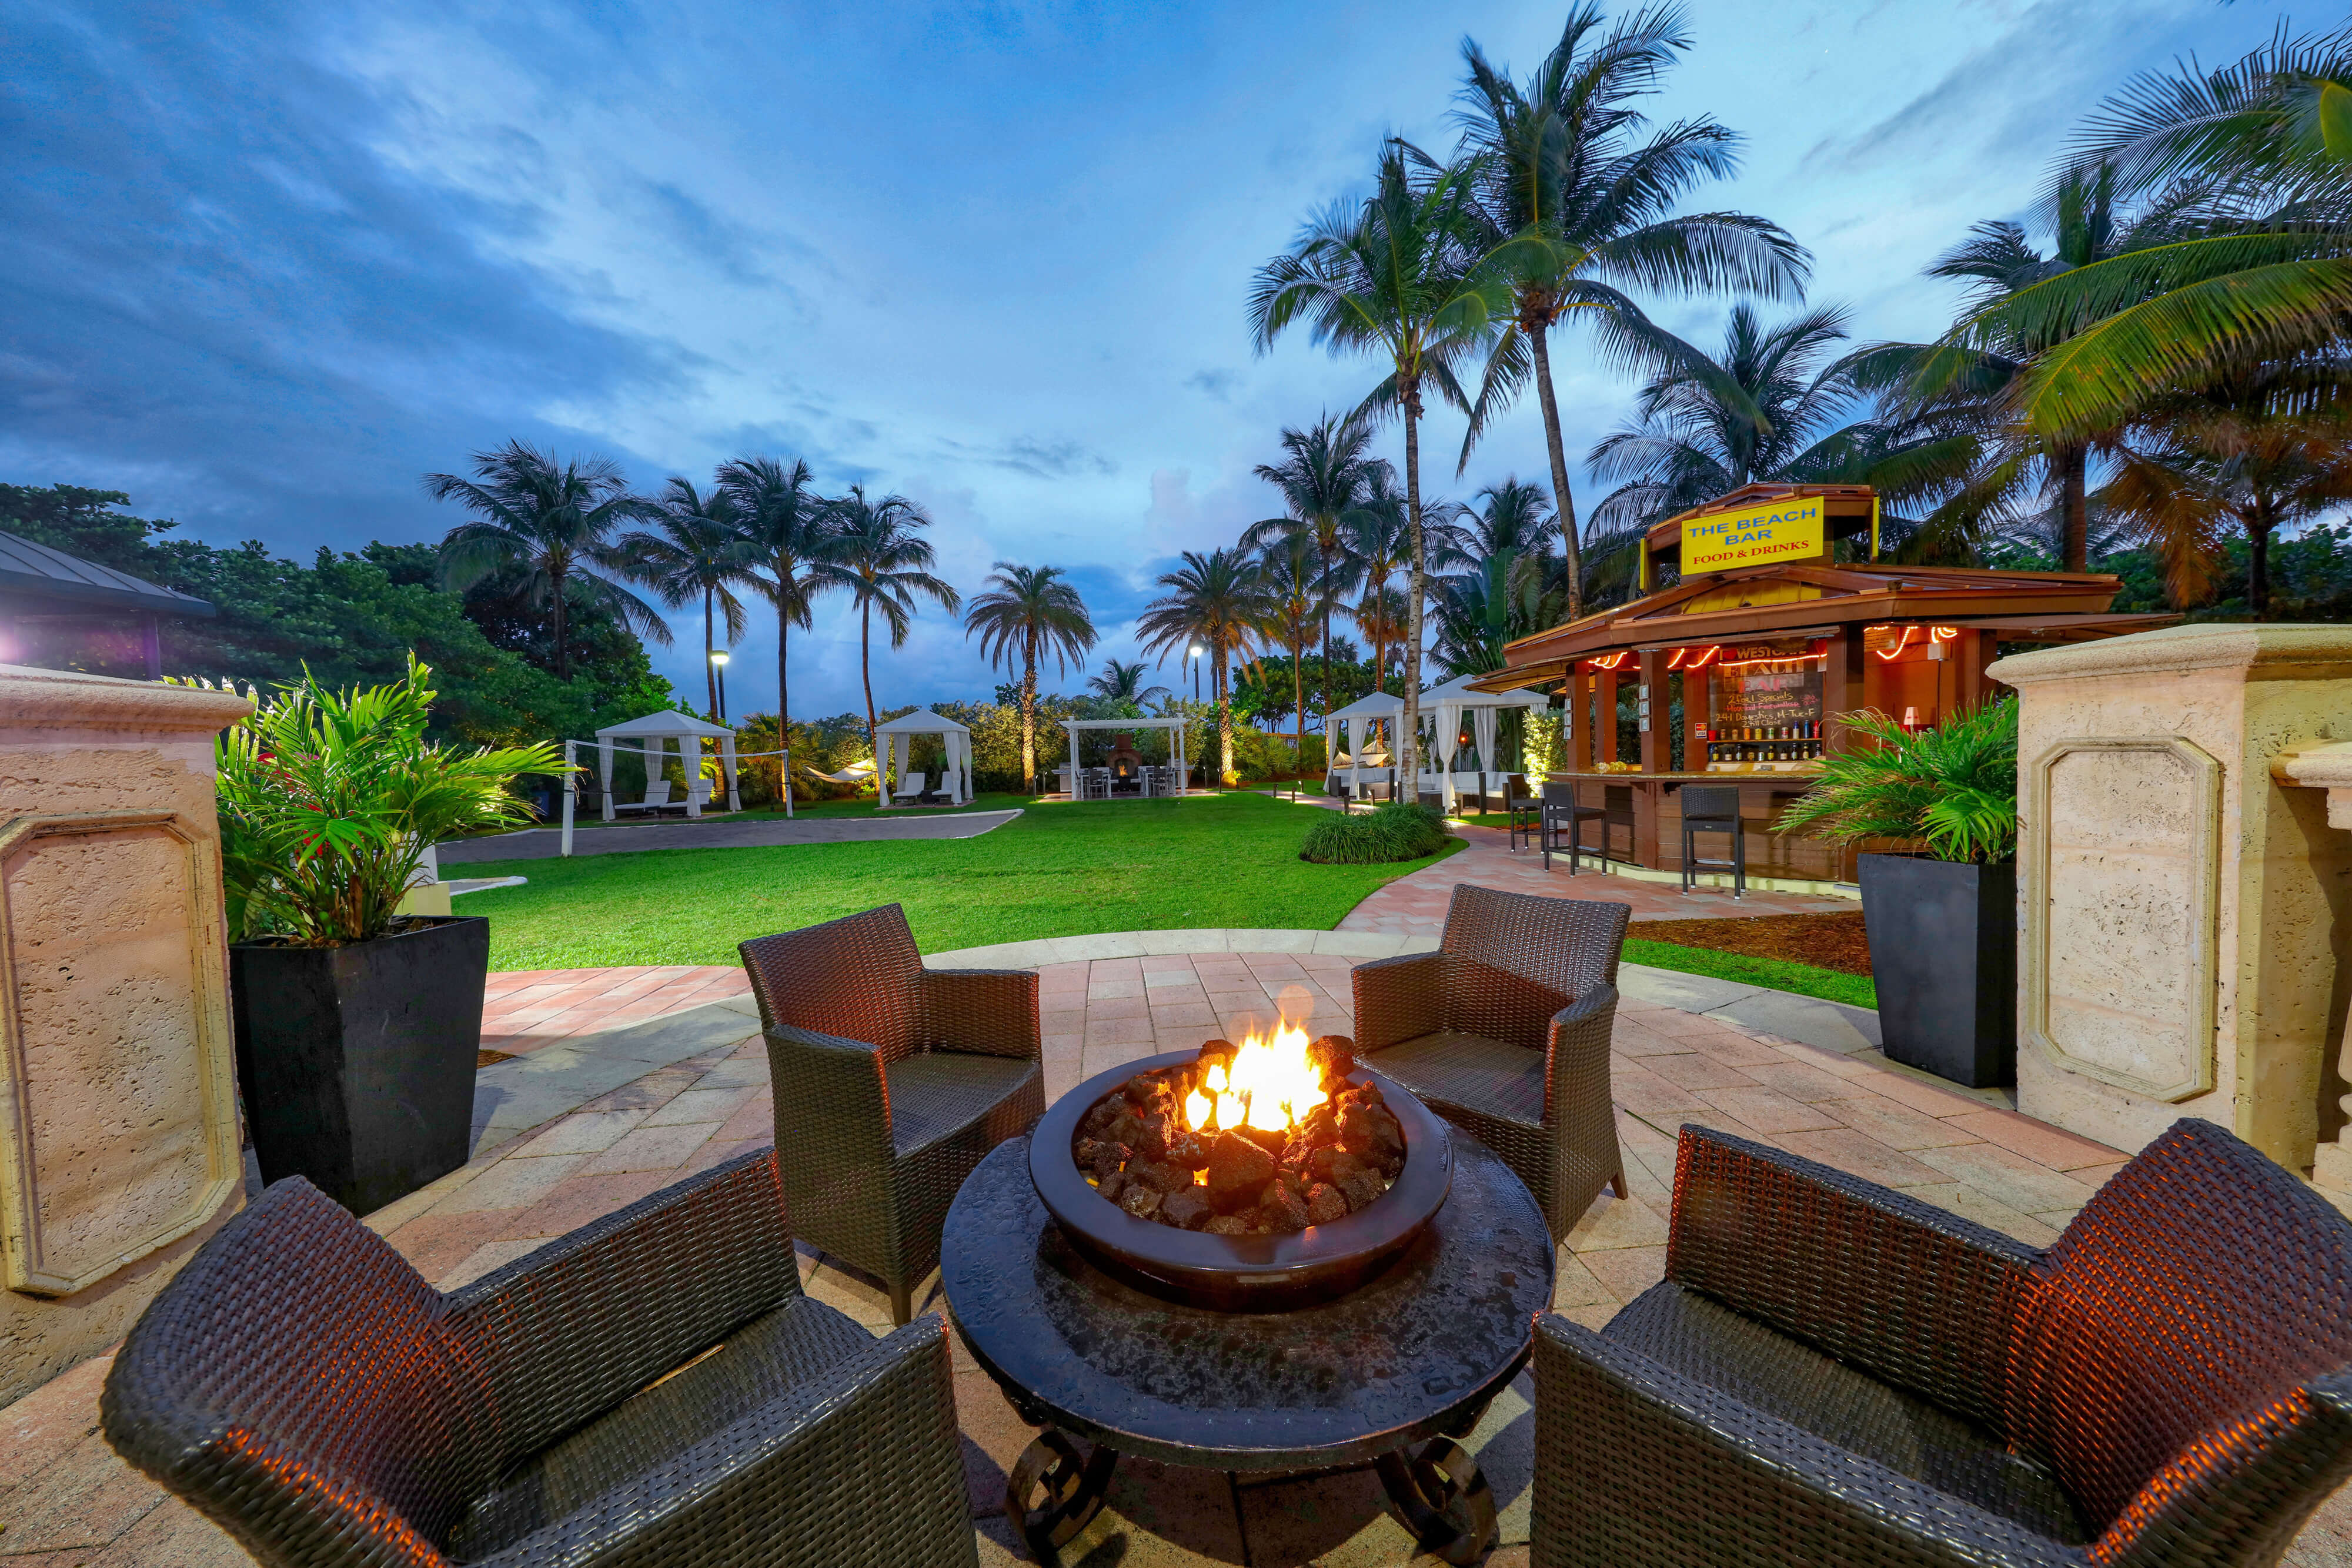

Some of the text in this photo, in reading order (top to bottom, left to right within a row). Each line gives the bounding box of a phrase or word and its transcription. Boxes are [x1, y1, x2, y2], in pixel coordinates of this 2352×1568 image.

[1689, 508, 1816, 537] THE BEACH
[1725, 530, 1772, 546] BAR
[1693, 552, 1733, 564] FOOD
[1751, 540, 1809, 556] DRINKS
[1724, 659, 1804, 677] BEACH
[1739, 677, 1788, 694] BAR
[1758, 691, 1794, 703] Specials
